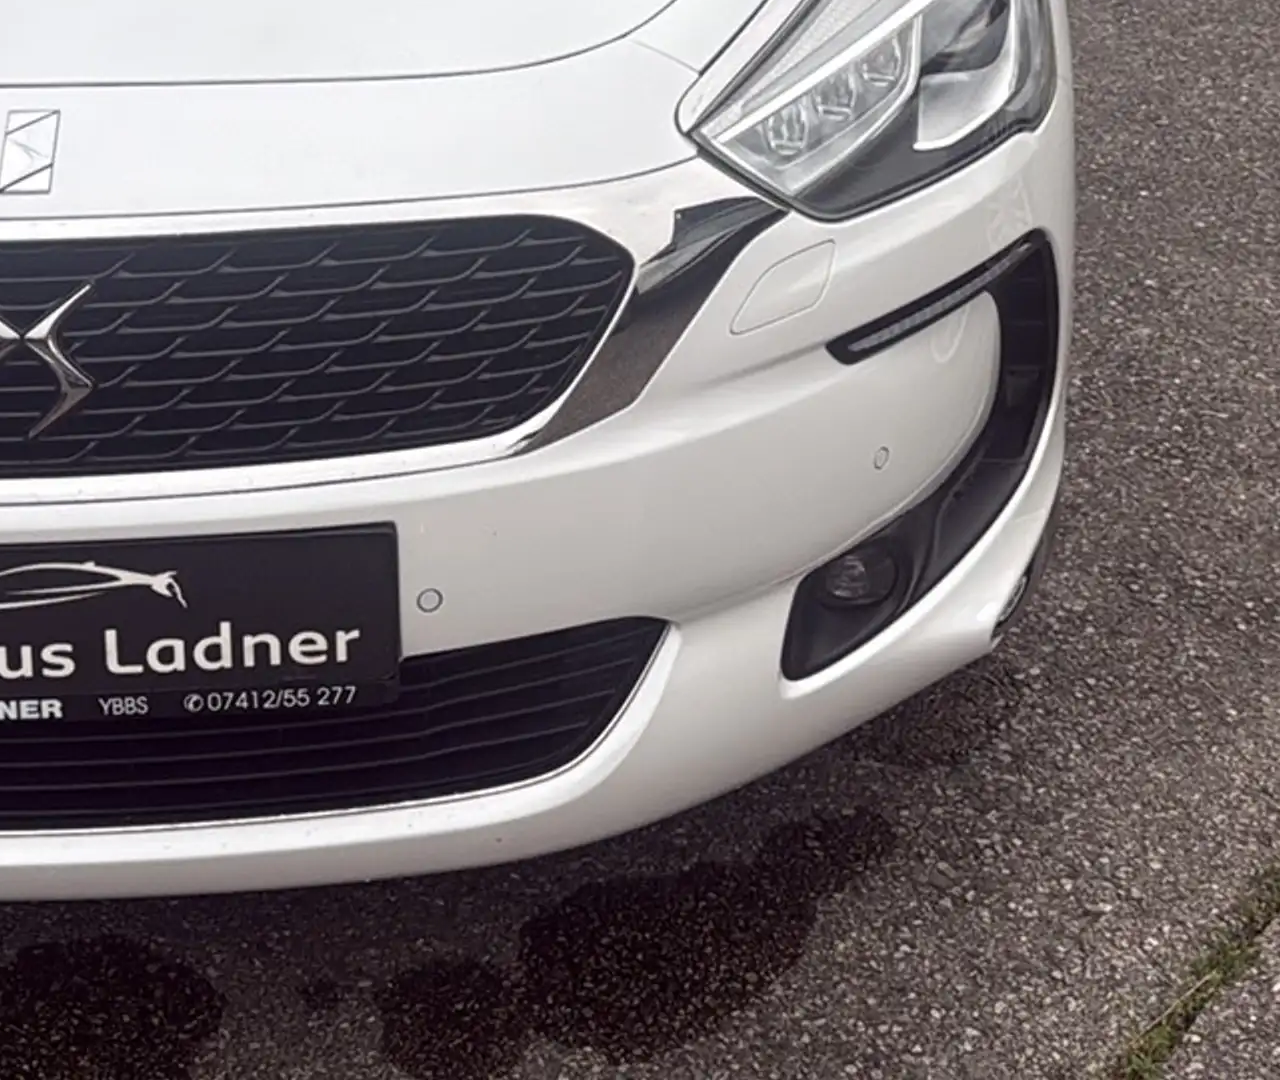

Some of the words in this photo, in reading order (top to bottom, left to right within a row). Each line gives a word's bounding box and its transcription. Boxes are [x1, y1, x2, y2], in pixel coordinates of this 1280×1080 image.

[104, 620, 361, 676] Ladner
[97, 694, 150, 717] YBBS
[316, 684, 357, 706] 277
